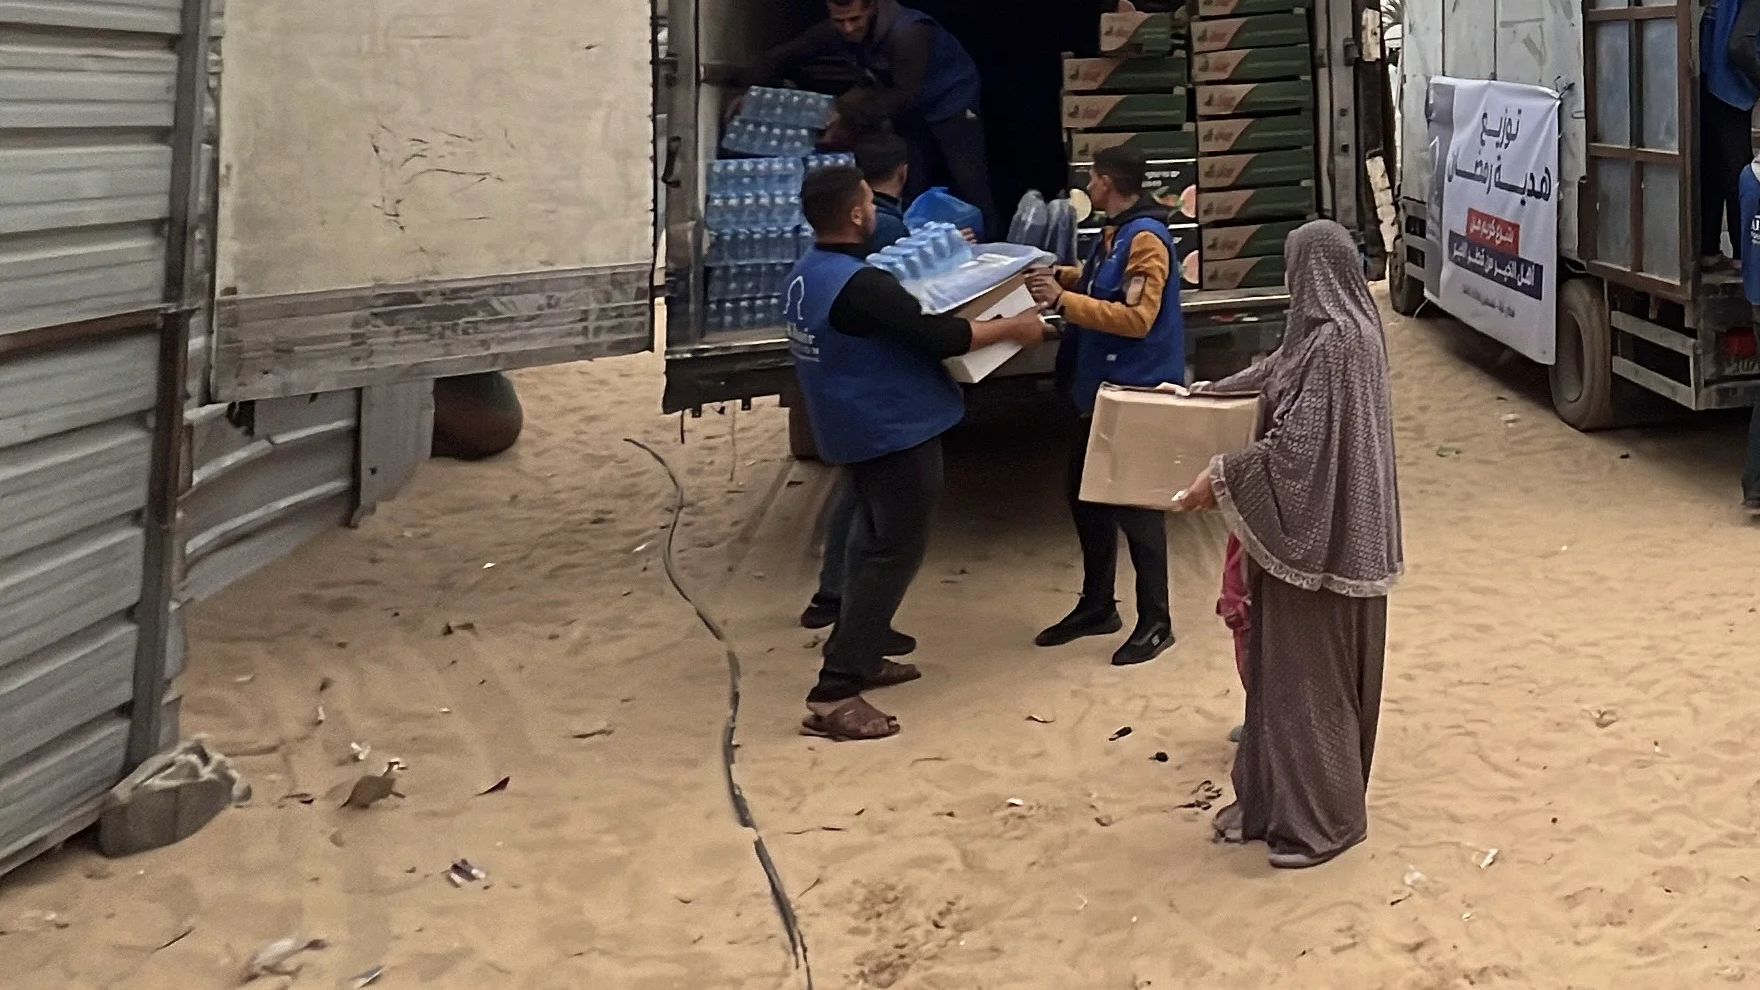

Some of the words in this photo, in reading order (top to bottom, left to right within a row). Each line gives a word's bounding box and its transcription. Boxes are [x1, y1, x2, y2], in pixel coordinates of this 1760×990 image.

[1480, 107, 1522, 150] توزيع
[1447, 148, 1493, 196] رمضان
[1494, 154, 1552, 206] هدية
